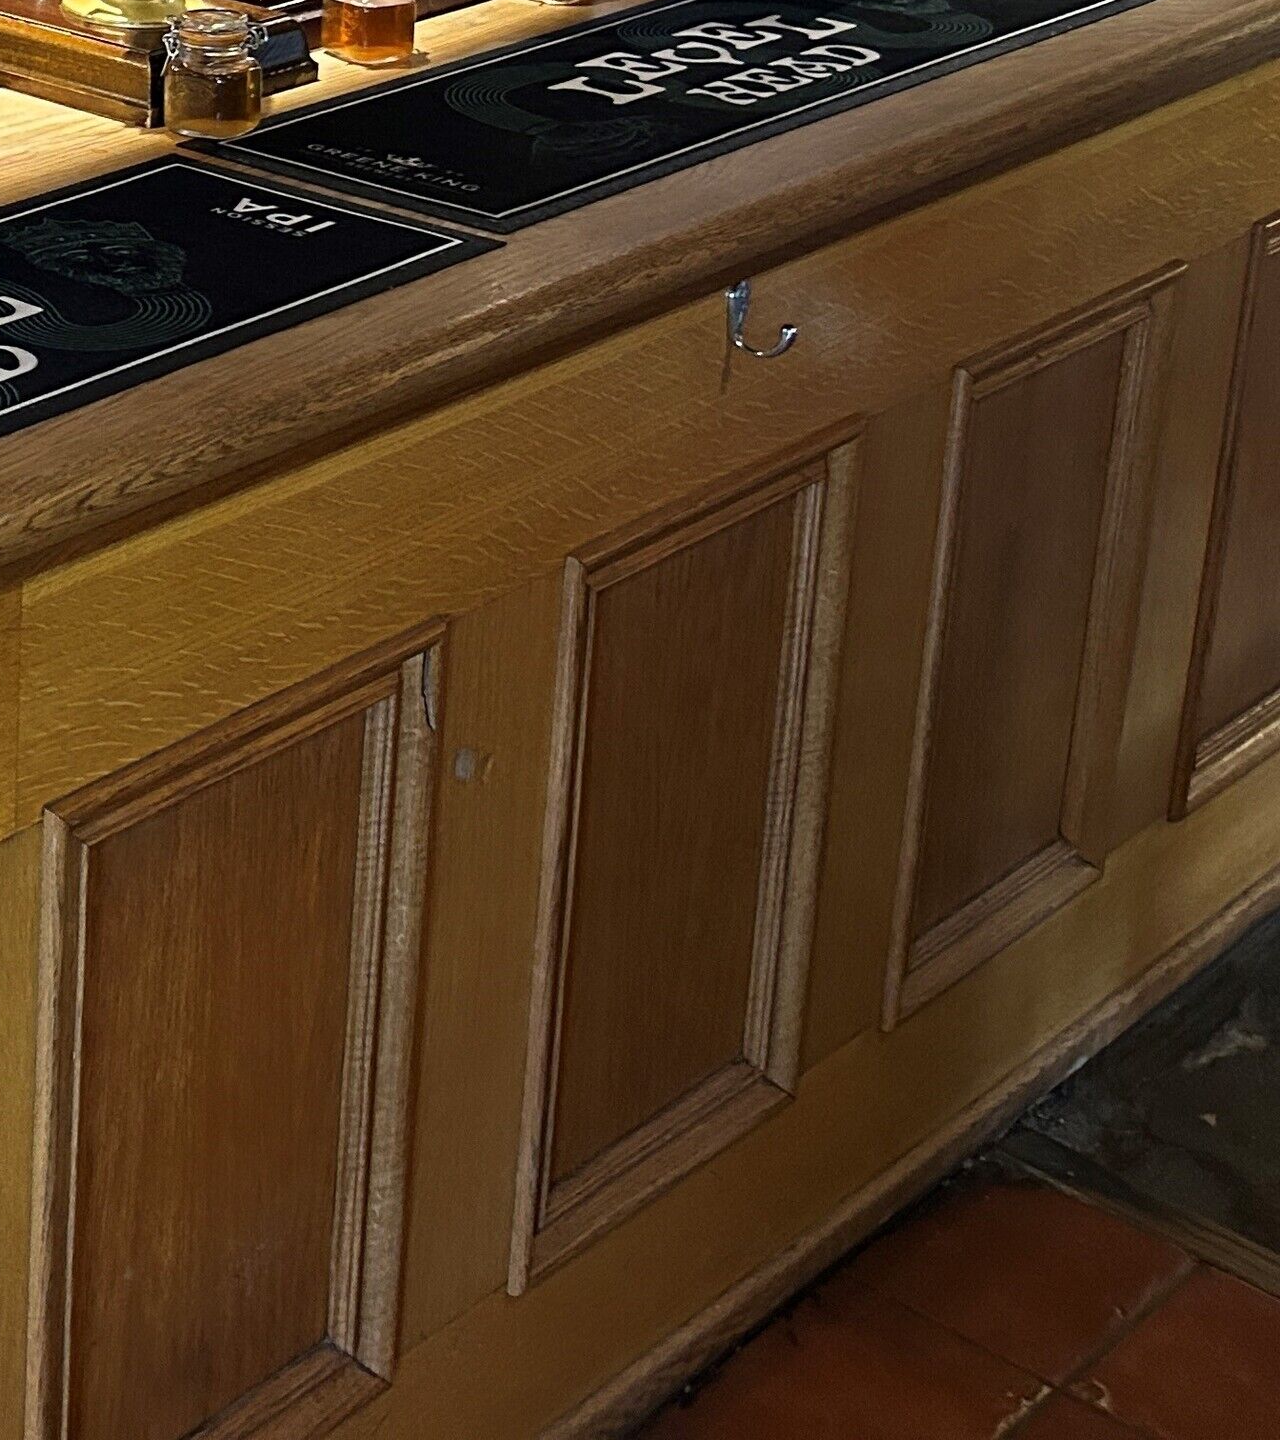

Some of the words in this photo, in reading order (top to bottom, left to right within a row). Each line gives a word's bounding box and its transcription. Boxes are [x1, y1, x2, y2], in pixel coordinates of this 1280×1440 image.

[548, 7, 858, 109] LEVEL
[686, 41, 883, 106] HEAD
[306, 143, 409, 174] GREENE
[412, 170, 482, 192] KING
[209, 206, 307, 238] SESSION
[232, 197, 336, 234] IPA
